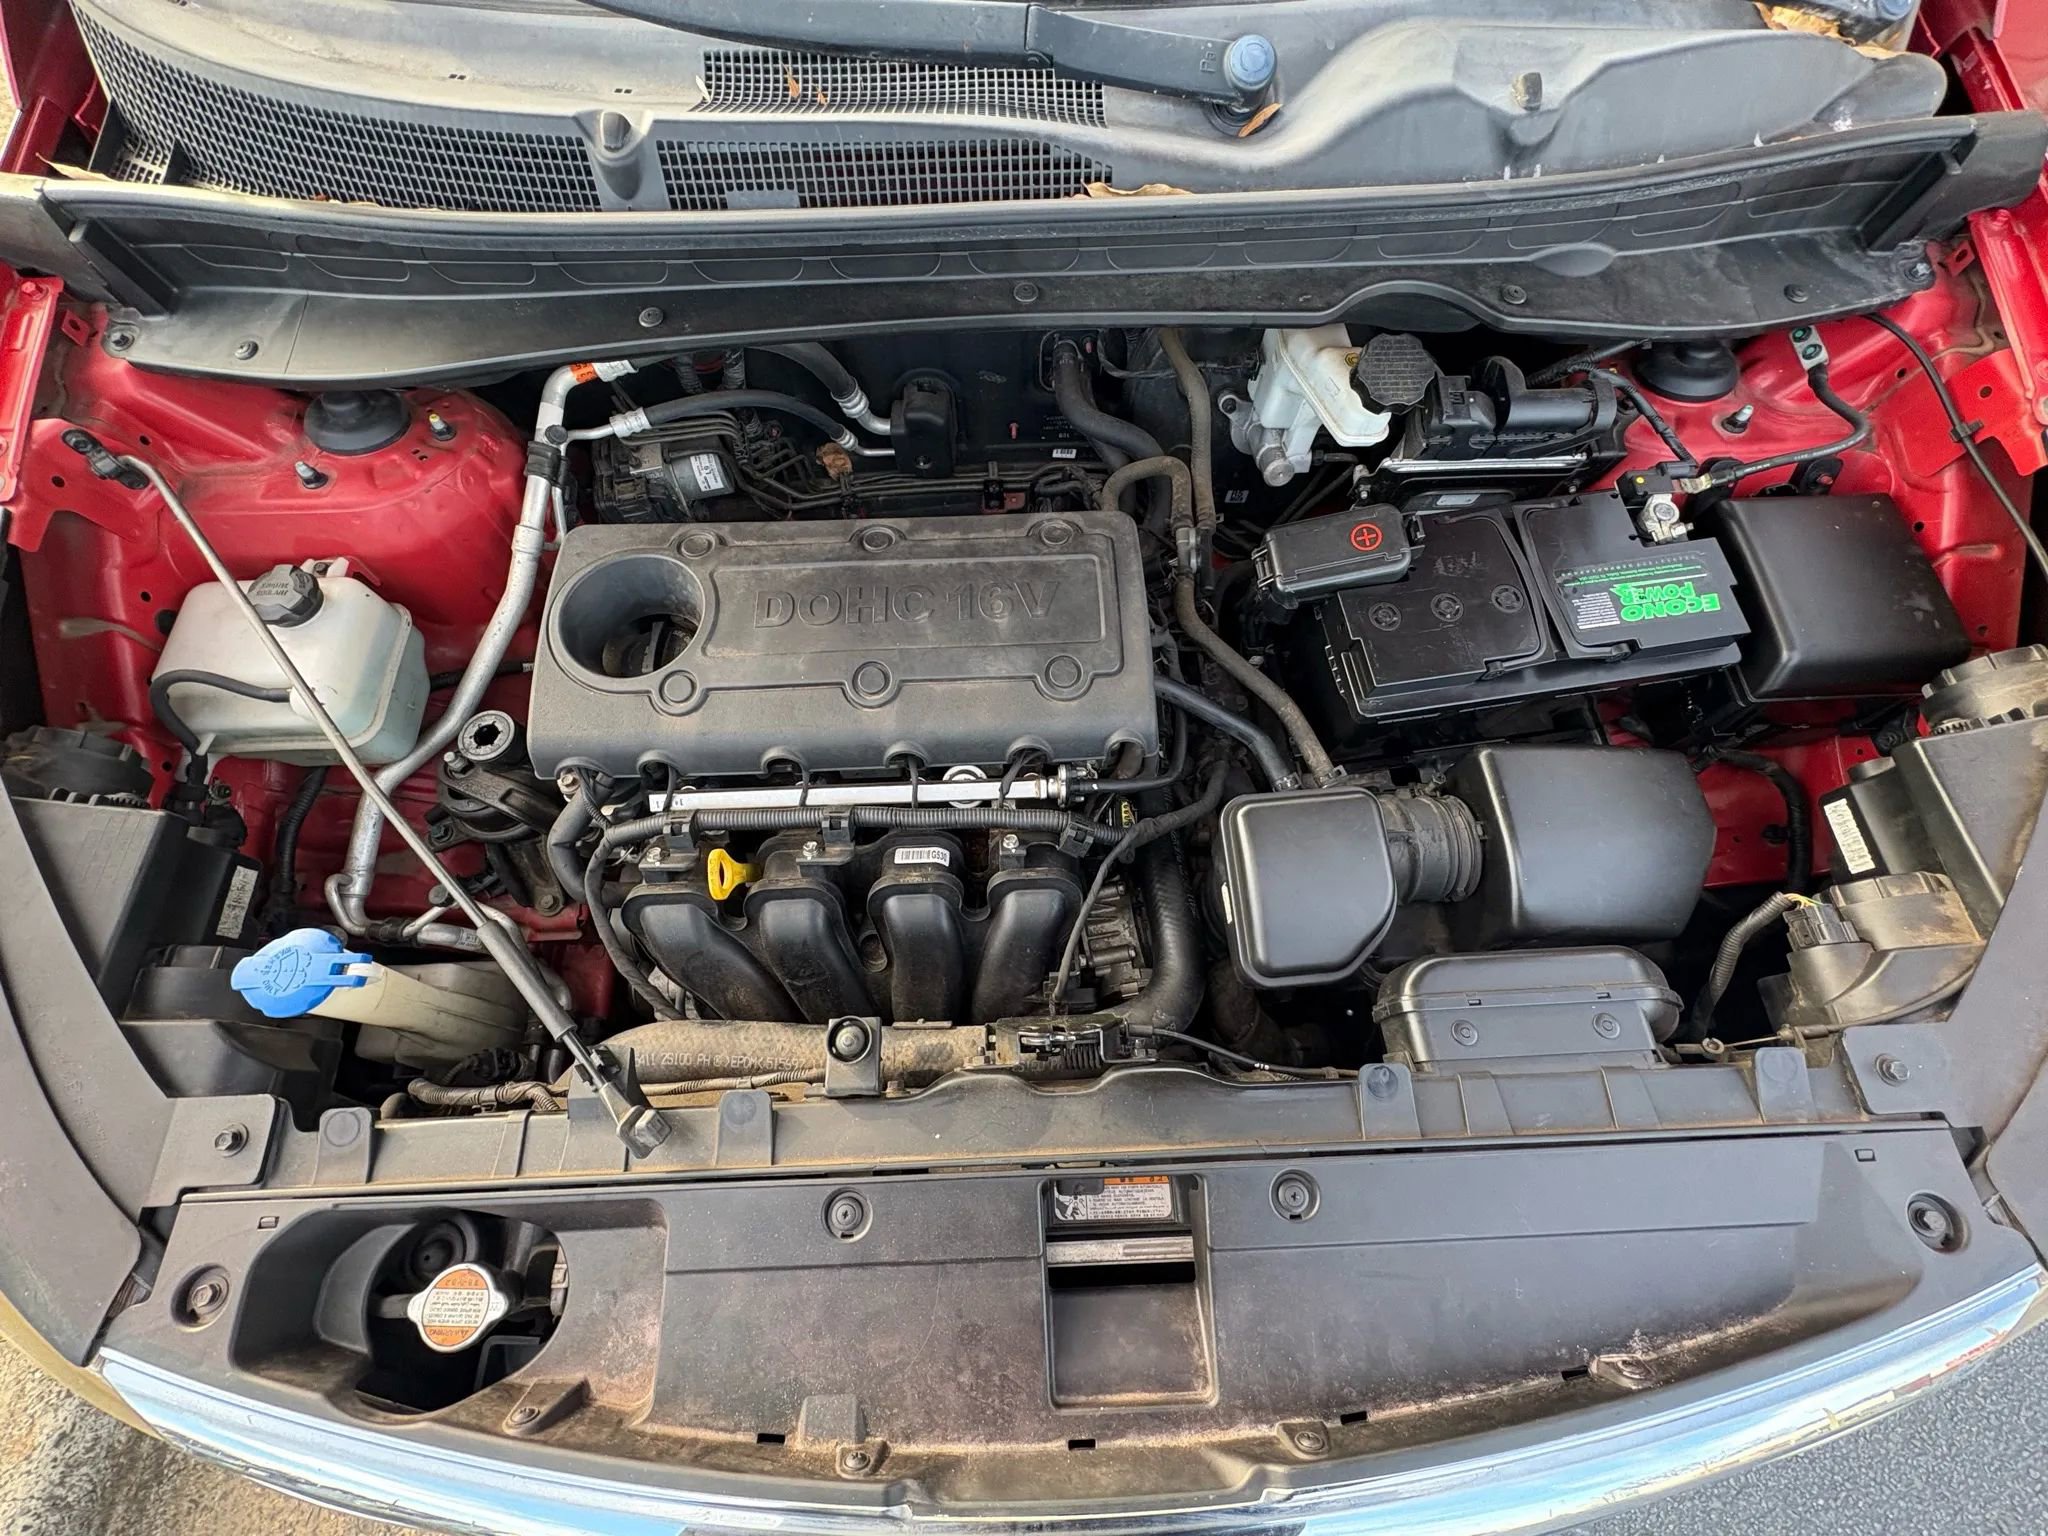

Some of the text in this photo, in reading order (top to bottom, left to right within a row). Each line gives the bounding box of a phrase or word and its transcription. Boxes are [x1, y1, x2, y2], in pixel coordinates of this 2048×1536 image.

[752, 580, 1060, 629] DOHC 16V
[1617, 581, 1696, 606] POWER
[1620, 593, 1721, 622] ECONO
